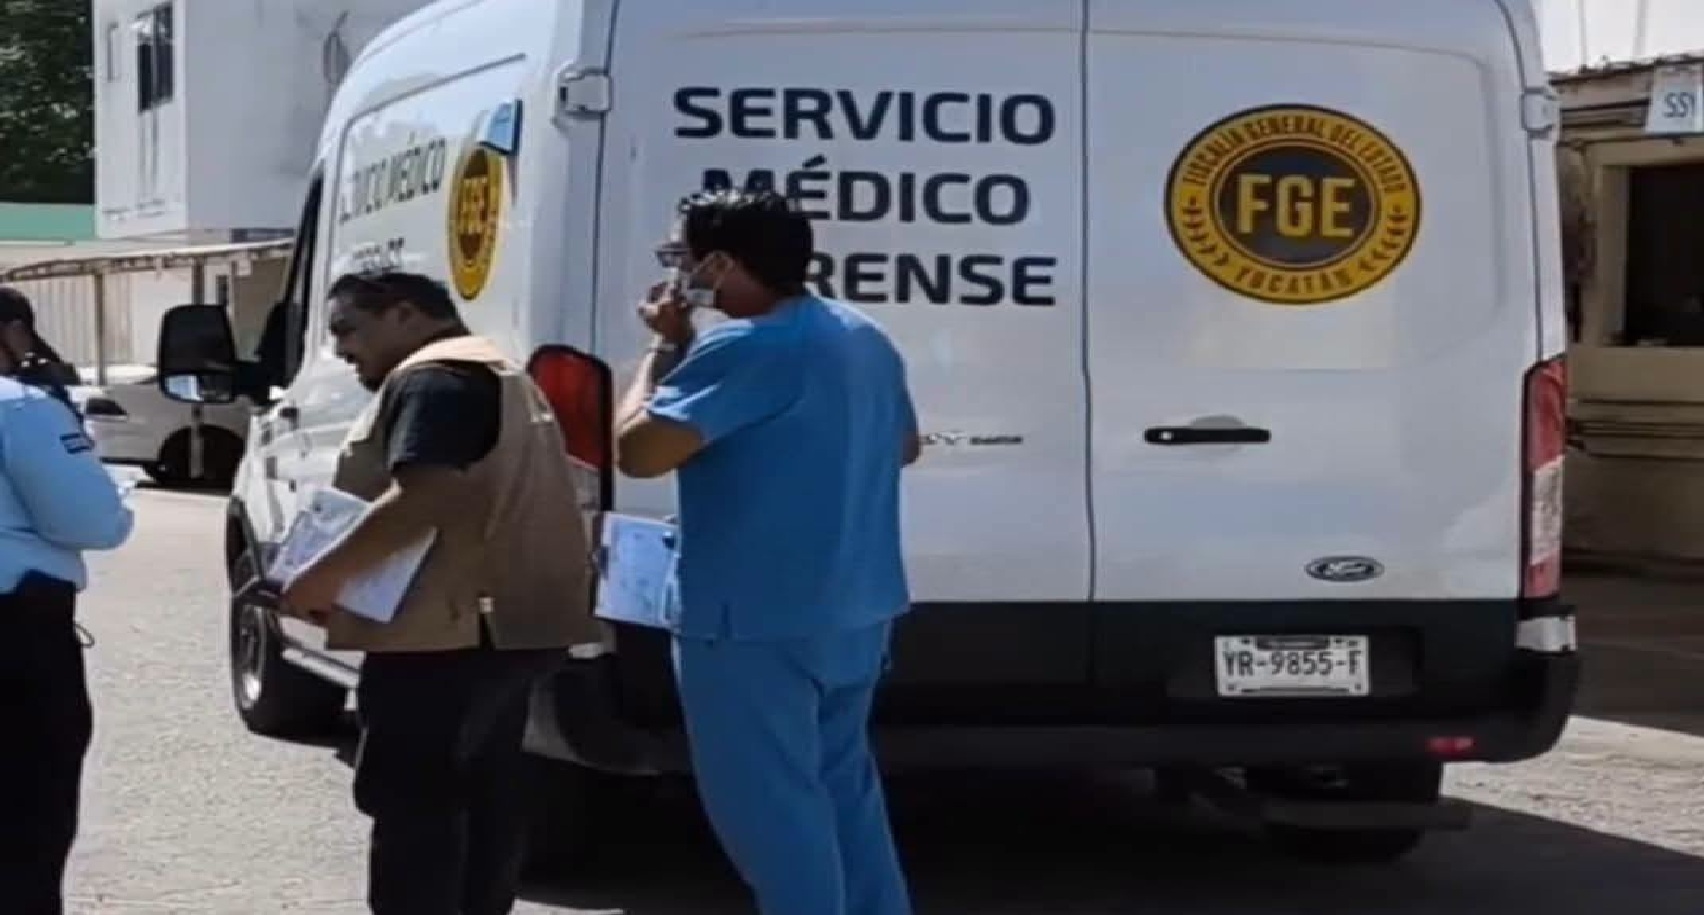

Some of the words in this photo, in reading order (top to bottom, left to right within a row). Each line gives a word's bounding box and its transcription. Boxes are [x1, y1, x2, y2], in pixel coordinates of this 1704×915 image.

[673, 86, 1056, 144] SERVICIO
[1238, 173, 1356, 238] FGE
[806, 252, 1057, 306] RENSE
[1222, 650, 1361, 677] YR-9855-F
